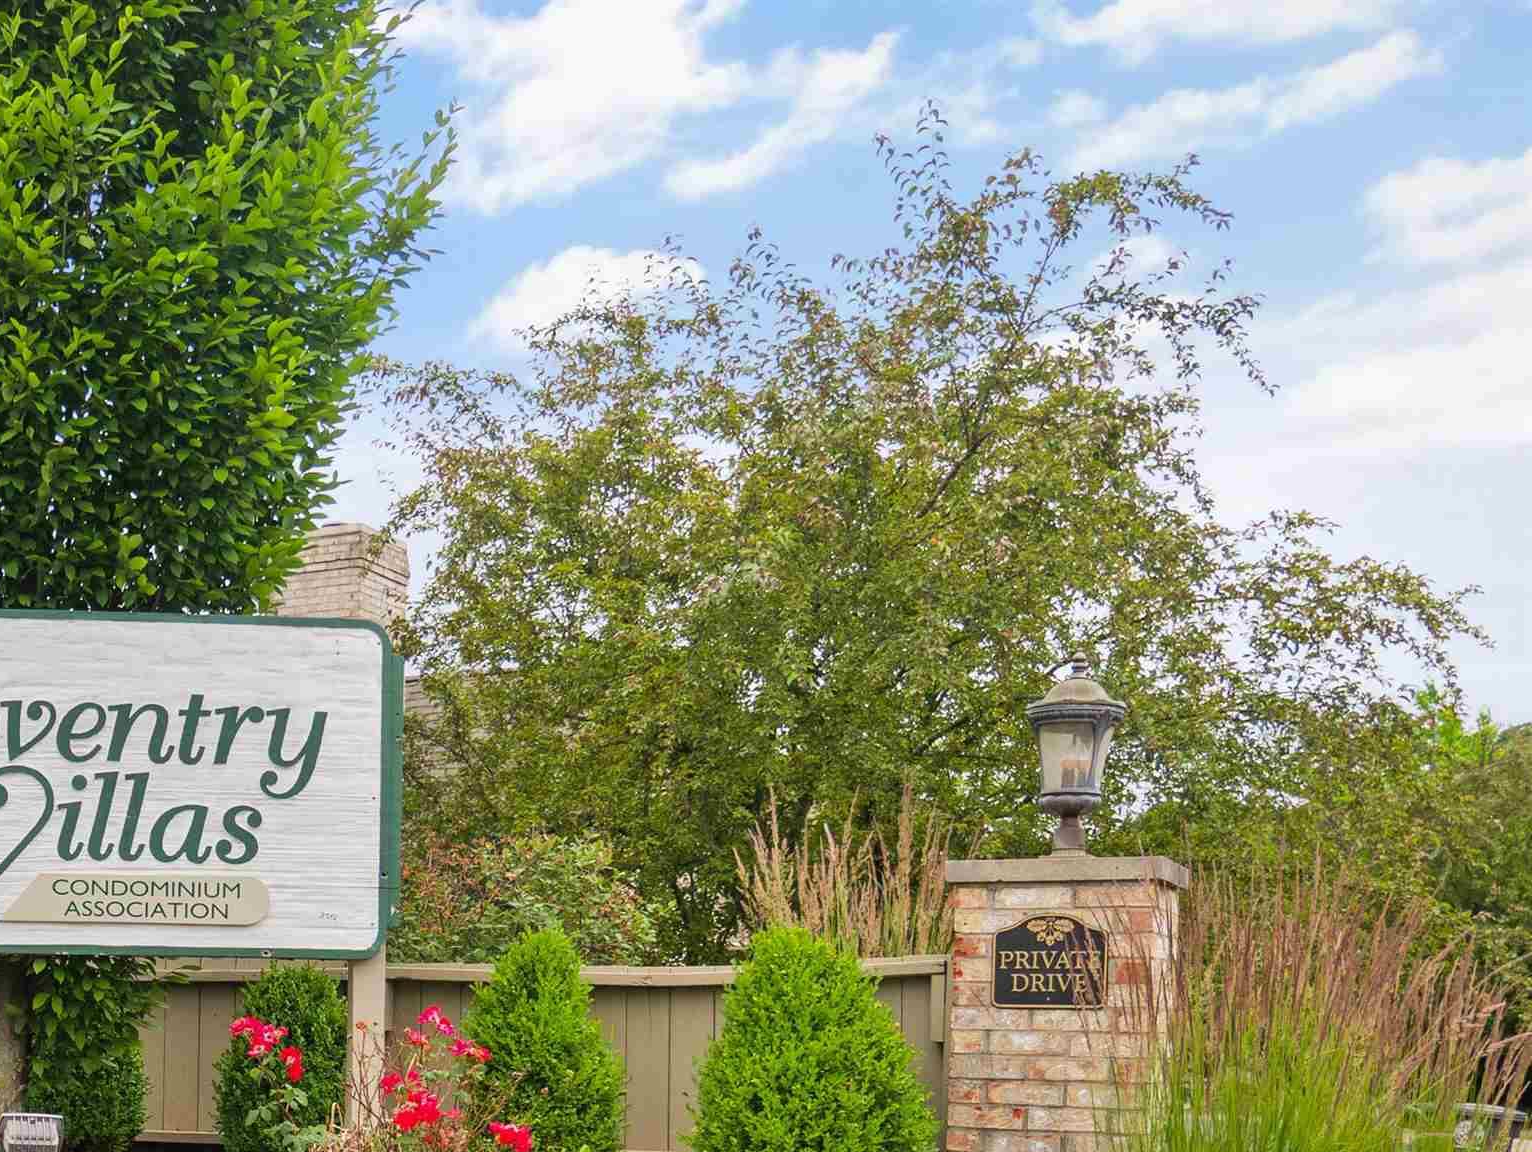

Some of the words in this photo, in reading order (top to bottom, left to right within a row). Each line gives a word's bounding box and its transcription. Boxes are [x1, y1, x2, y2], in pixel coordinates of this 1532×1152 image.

[52, 879, 242, 899] CONDOMINIUM
[64, 901, 229, 919] ASSOCIATION
[1011, 973, 1088, 992] DRIVE
